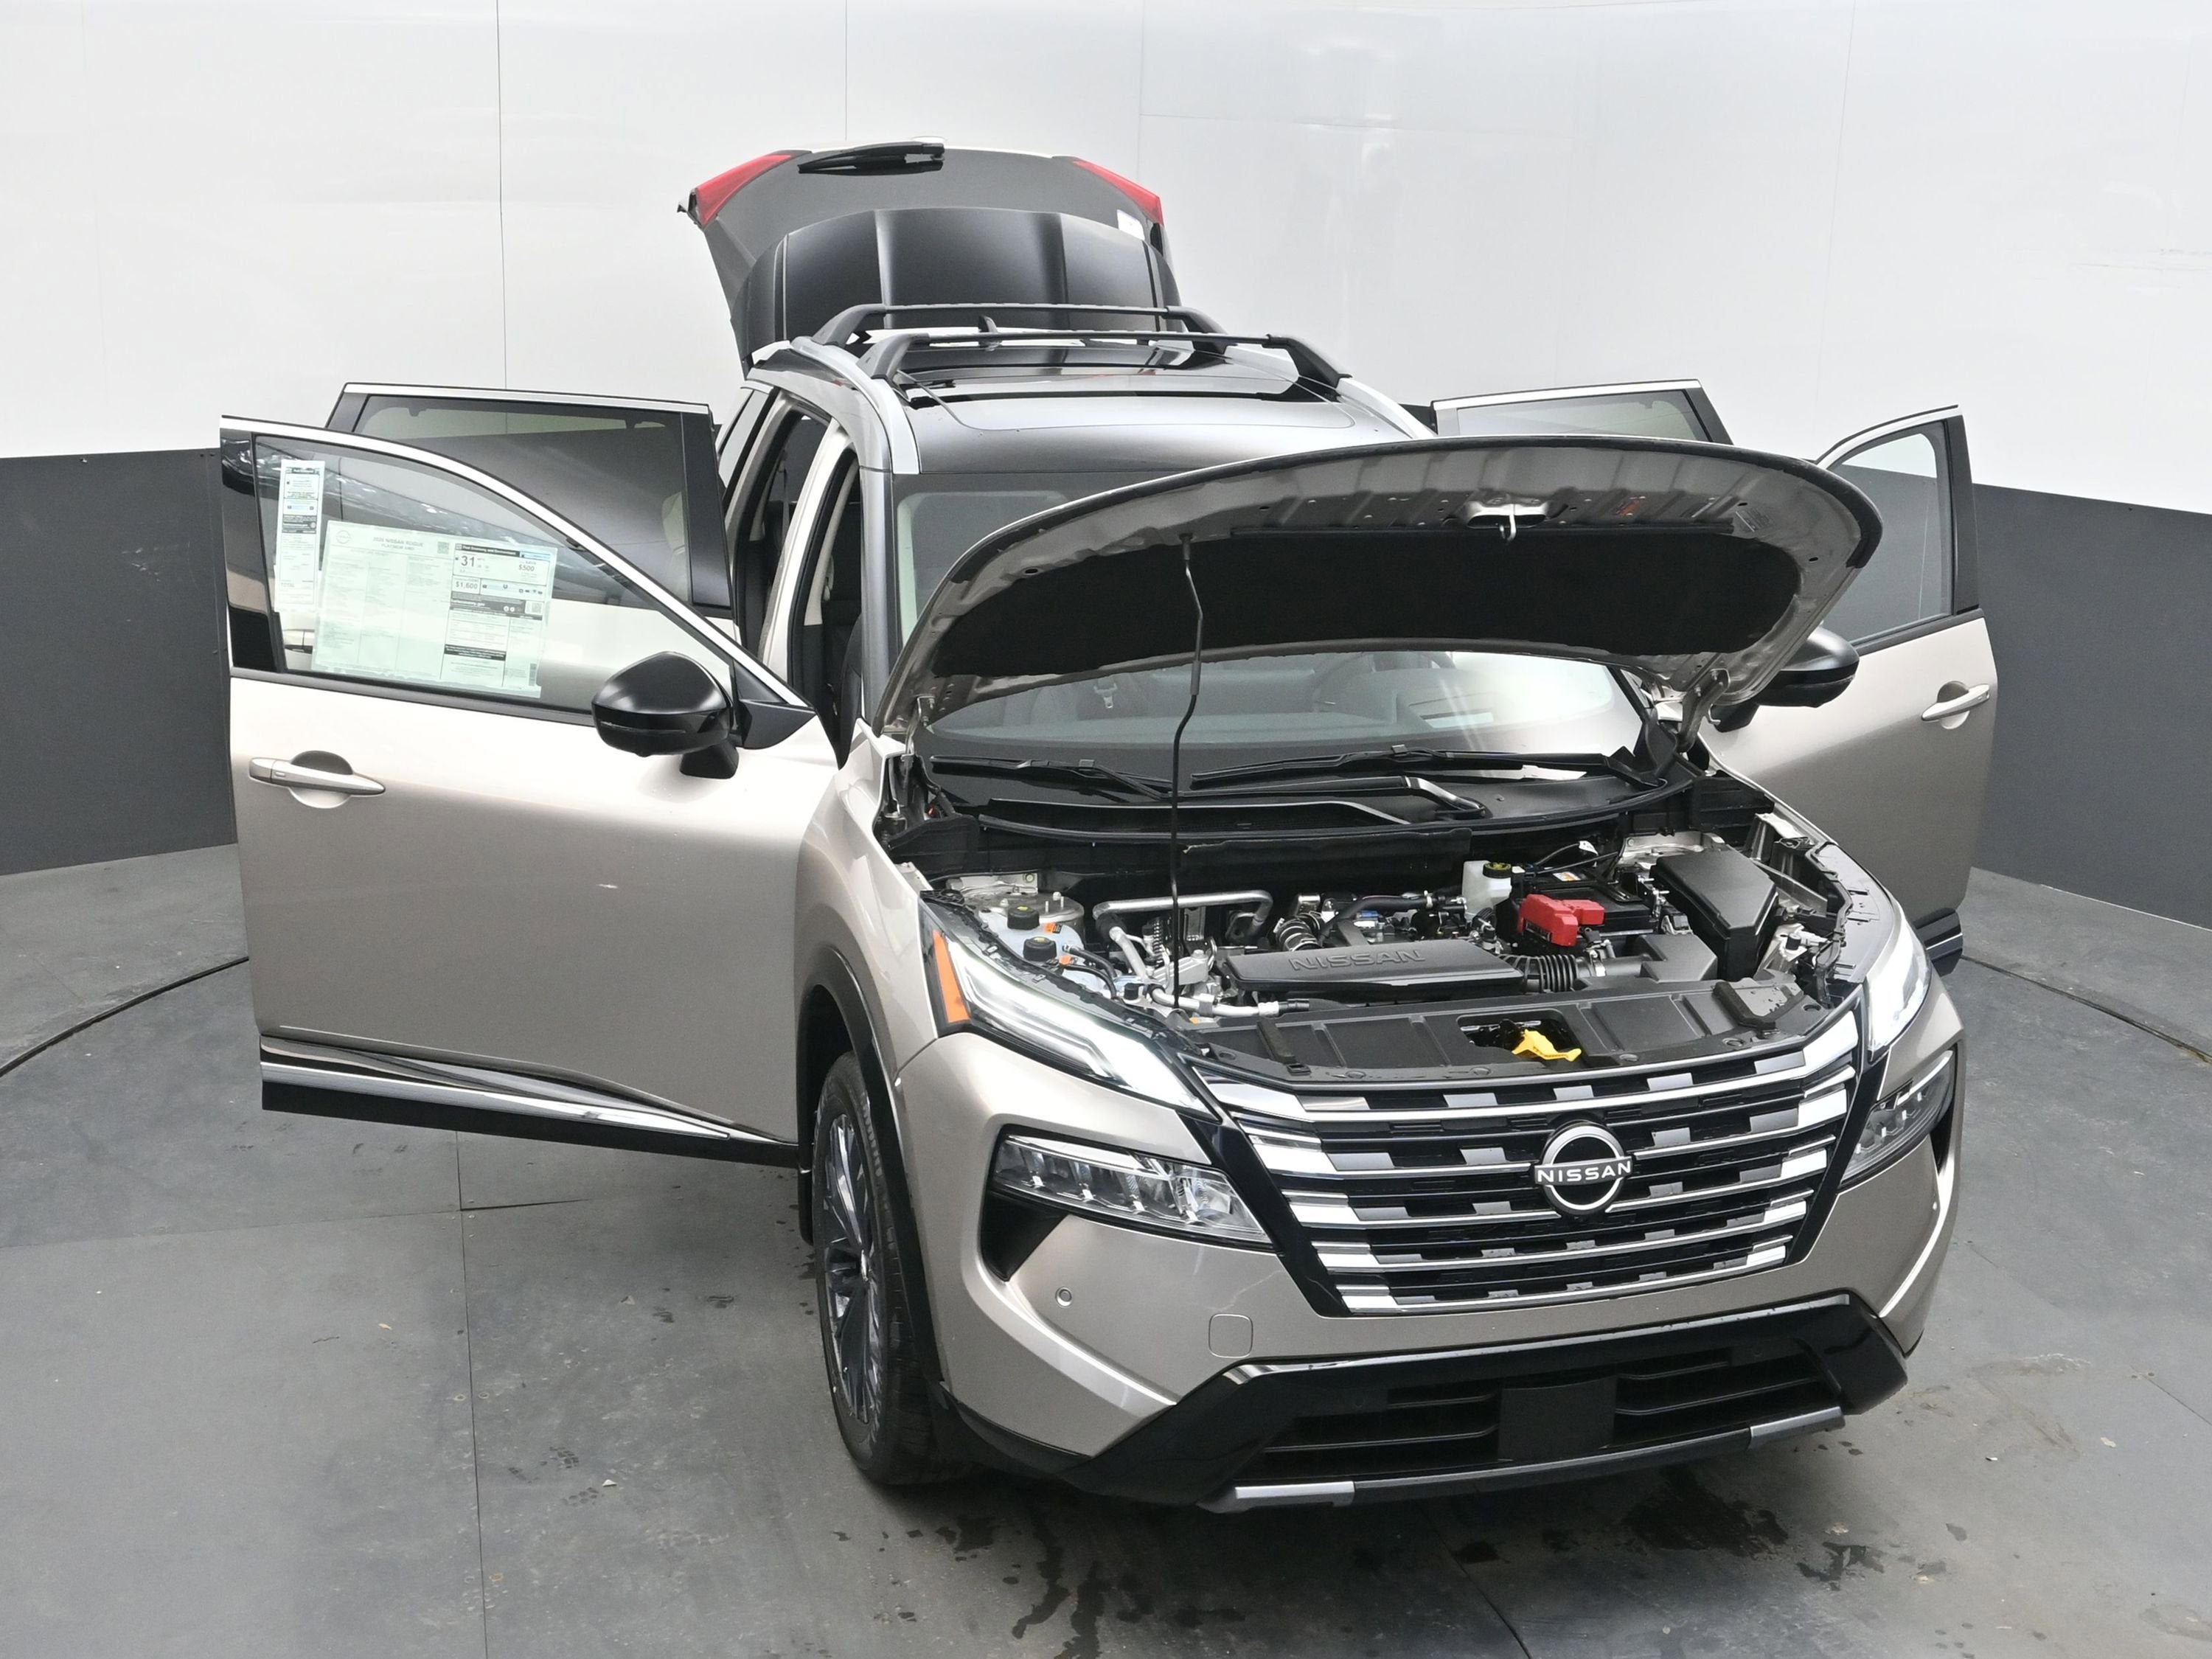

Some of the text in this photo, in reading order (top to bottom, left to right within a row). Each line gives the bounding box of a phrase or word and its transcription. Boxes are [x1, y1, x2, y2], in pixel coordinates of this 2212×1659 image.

[461, 555, 475, 567] 31
[1289, 950, 1426, 971] NISSAN
[1537, 1161, 1631, 1183] NISSAN
